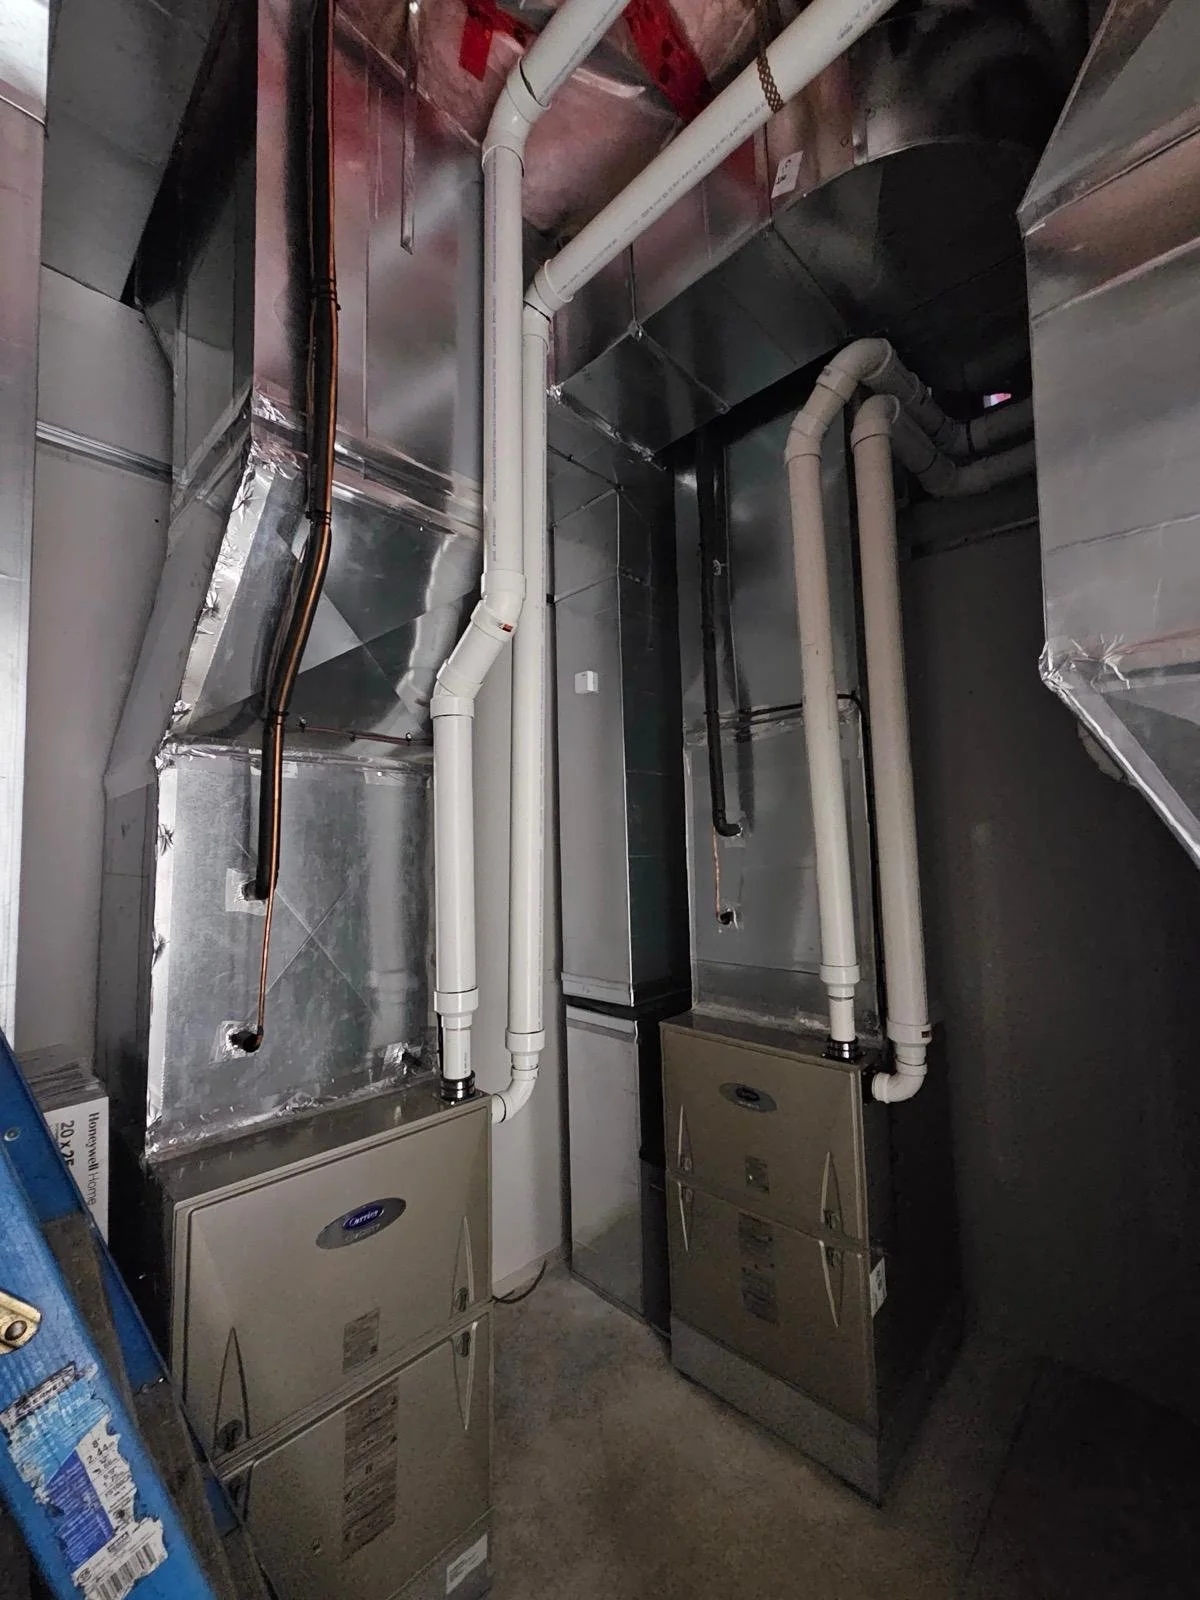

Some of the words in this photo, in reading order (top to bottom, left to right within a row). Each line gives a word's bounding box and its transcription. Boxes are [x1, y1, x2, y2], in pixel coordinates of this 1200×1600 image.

[60, 1120, 75, 1138] 20
[85, 1112, 100, 1171] Honeywell
[87, 1172, 98, 1206] Home
[349, 1209, 379, 1227] Carrier
